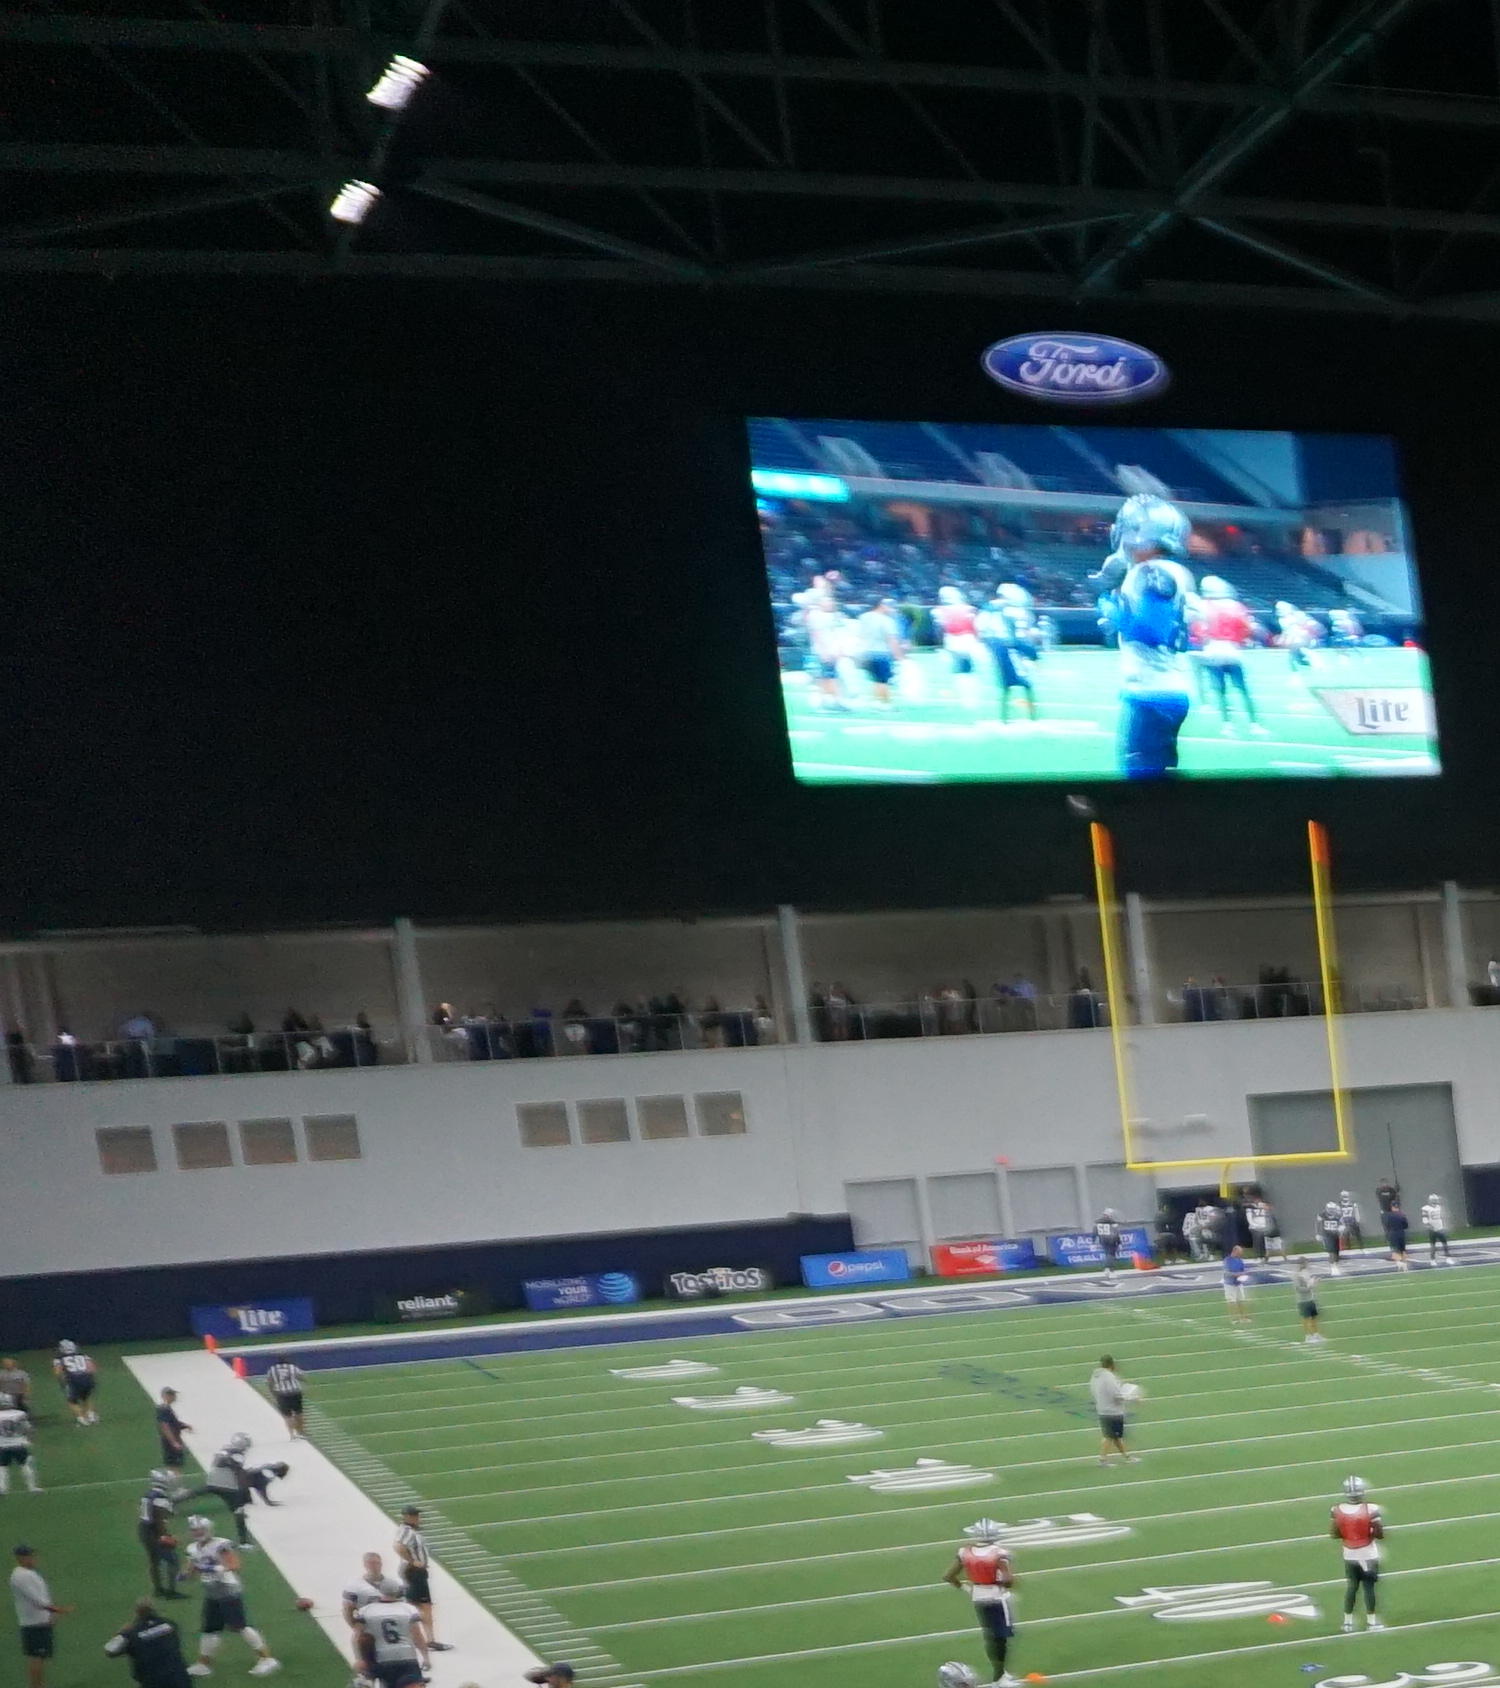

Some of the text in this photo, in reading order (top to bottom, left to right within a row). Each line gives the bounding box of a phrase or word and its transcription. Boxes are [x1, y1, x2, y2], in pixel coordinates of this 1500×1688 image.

[1018, 338, 1132, 390] Ford
[1352, 695, 1412, 731] Lite
[848, 1262, 885, 1273] pepsi
[398, 1294, 457, 1311] reliant
[558, 1286, 588, 1295] YOUR
[238, 1308, 283, 1332] Lite
[61, 1356, 86, 1373] 50
[1113, 1580, 1312, 1622] 40
[381, 1618, 399, 1644] 6
